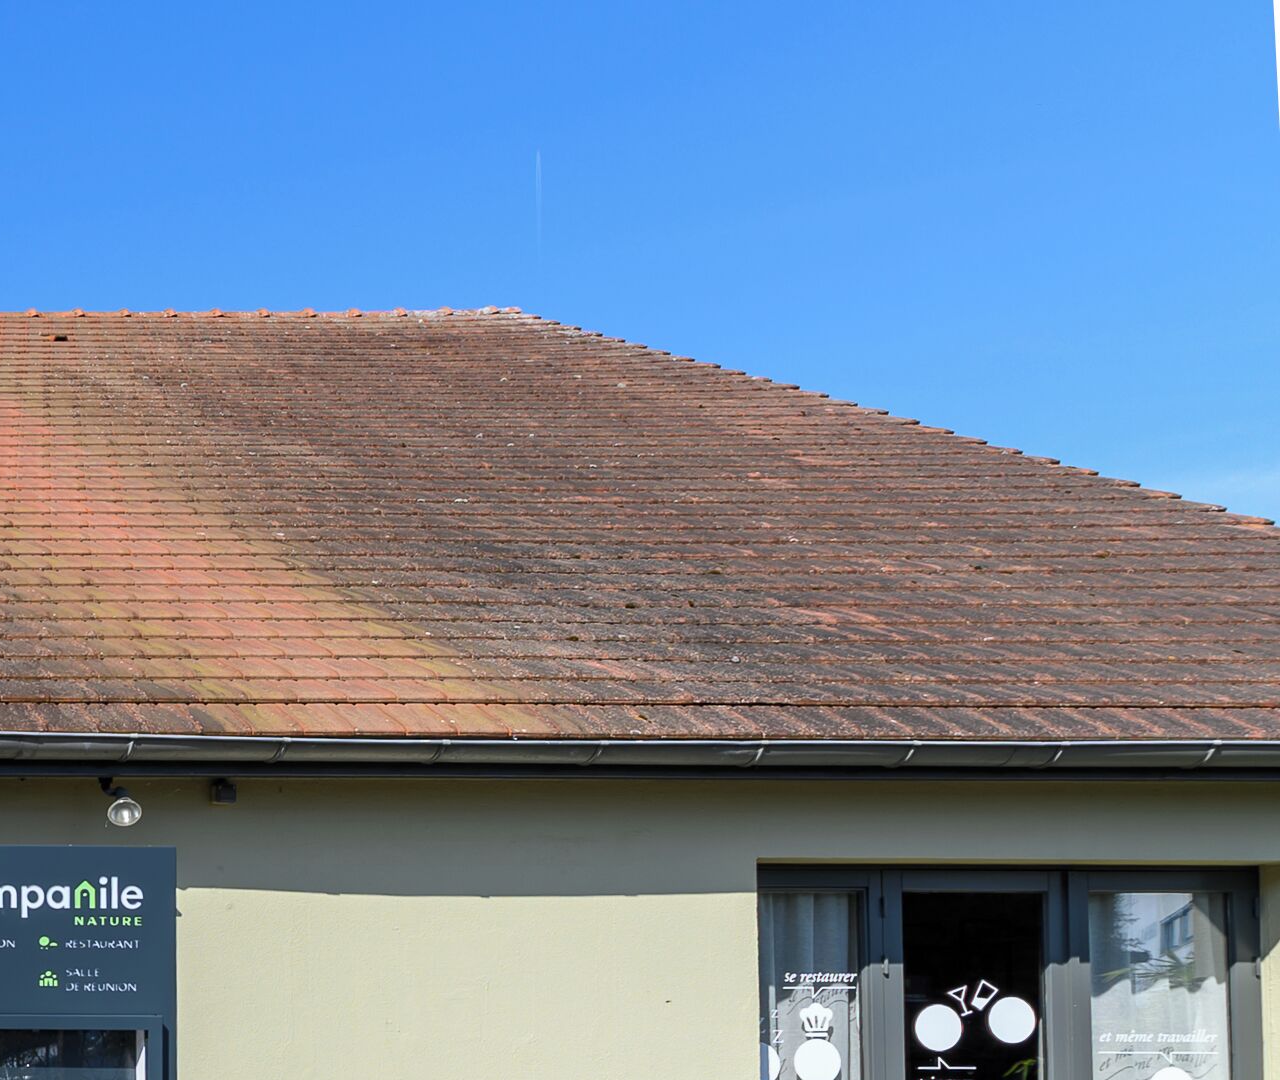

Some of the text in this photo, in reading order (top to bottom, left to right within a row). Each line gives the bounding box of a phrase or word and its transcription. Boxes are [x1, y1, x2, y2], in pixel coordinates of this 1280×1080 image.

[74, 916, 143, 926] NATURE
[65, 938, 139, 949] RESTAURANT
[65, 968, 101, 977] SALLE
[784, 972, 858, 982] se restaurer
[65, 982, 79, 992] DE
[1099, 1031, 1113, 1042] et
[1157, 1029, 1219, 1042] travailler
